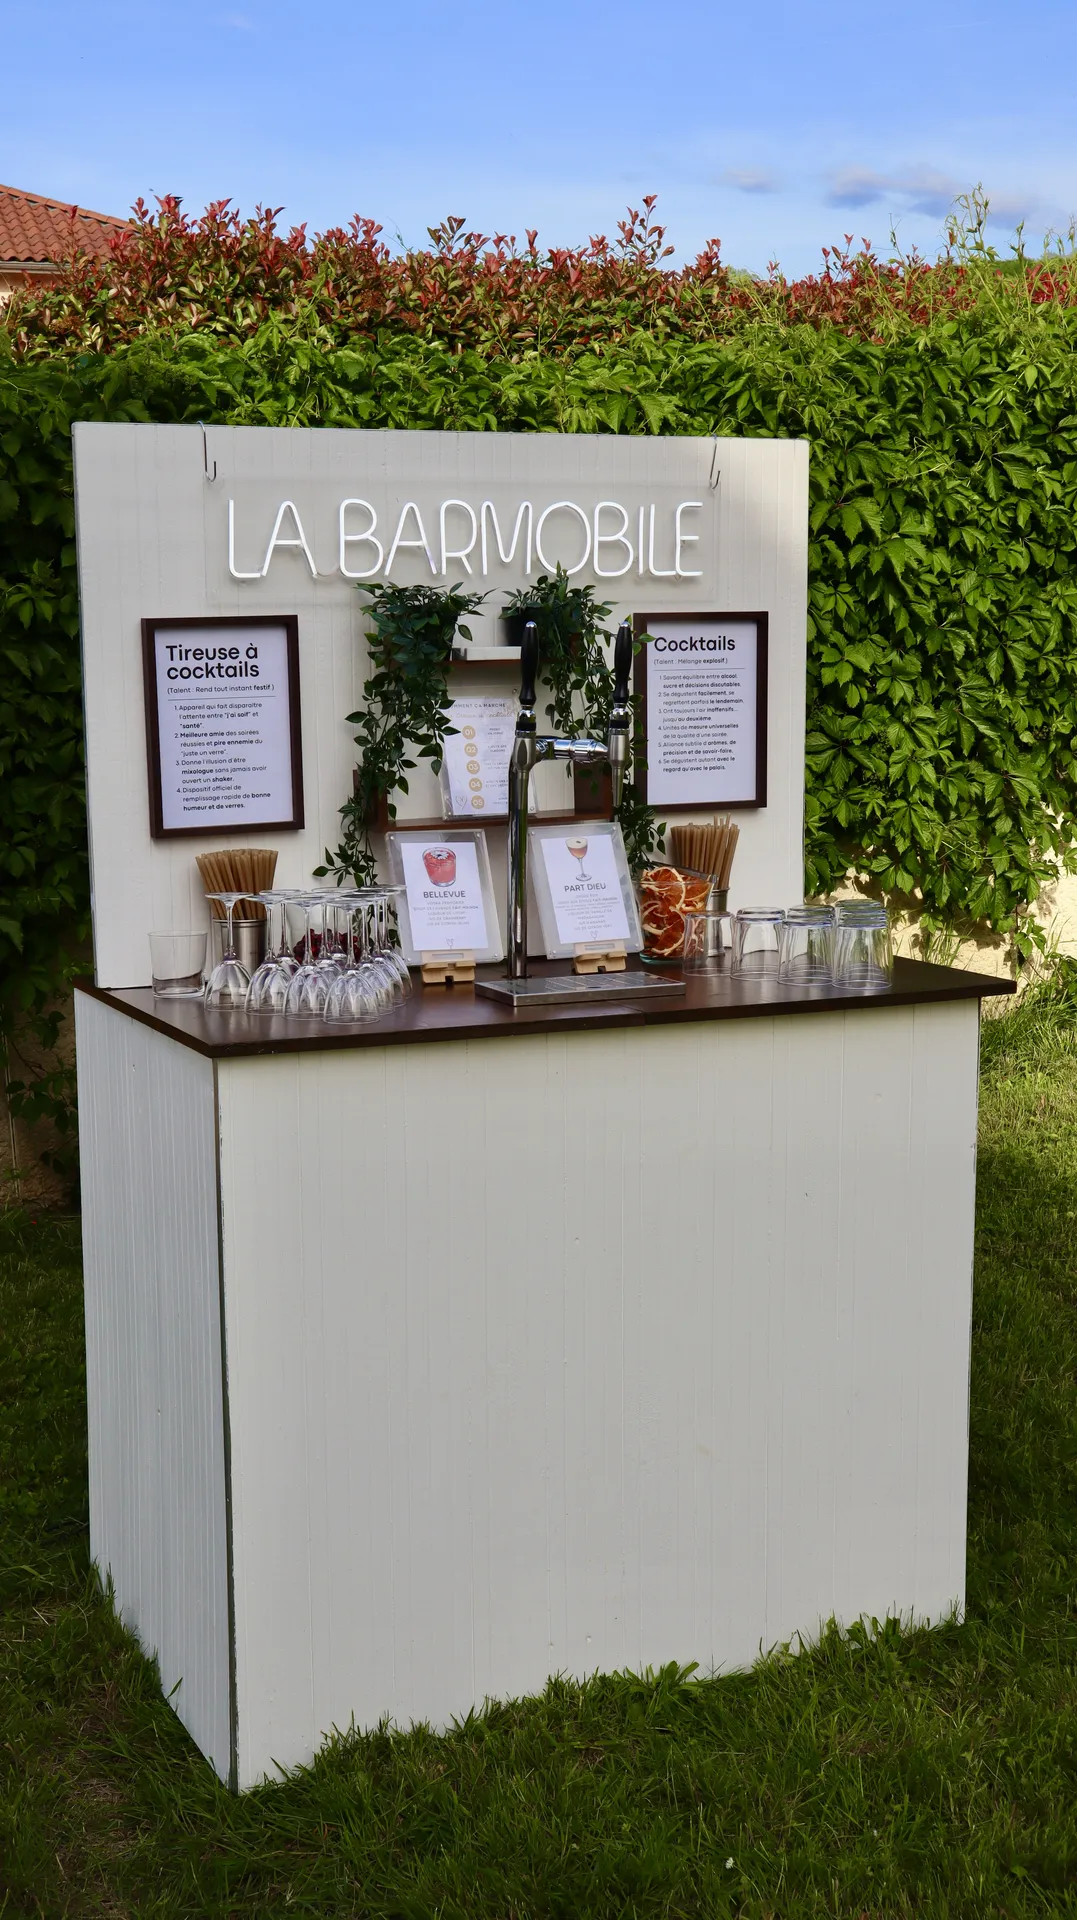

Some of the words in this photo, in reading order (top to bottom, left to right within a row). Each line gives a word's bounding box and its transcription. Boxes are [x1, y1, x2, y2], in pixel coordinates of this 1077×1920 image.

[228, 499, 318, 578] LA
[338, 498, 704, 578] BARMOBILE
[165, 644, 240, 661] Tireuse
[245, 643, 258, 660] à
[654, 636, 736, 652] Cocktails
[166, 661, 260, 680] cocktails
[230, 766, 251, 774] jamais
[423, 890, 466, 898] BELLEVUE
[564, 884, 585, 892] PART
